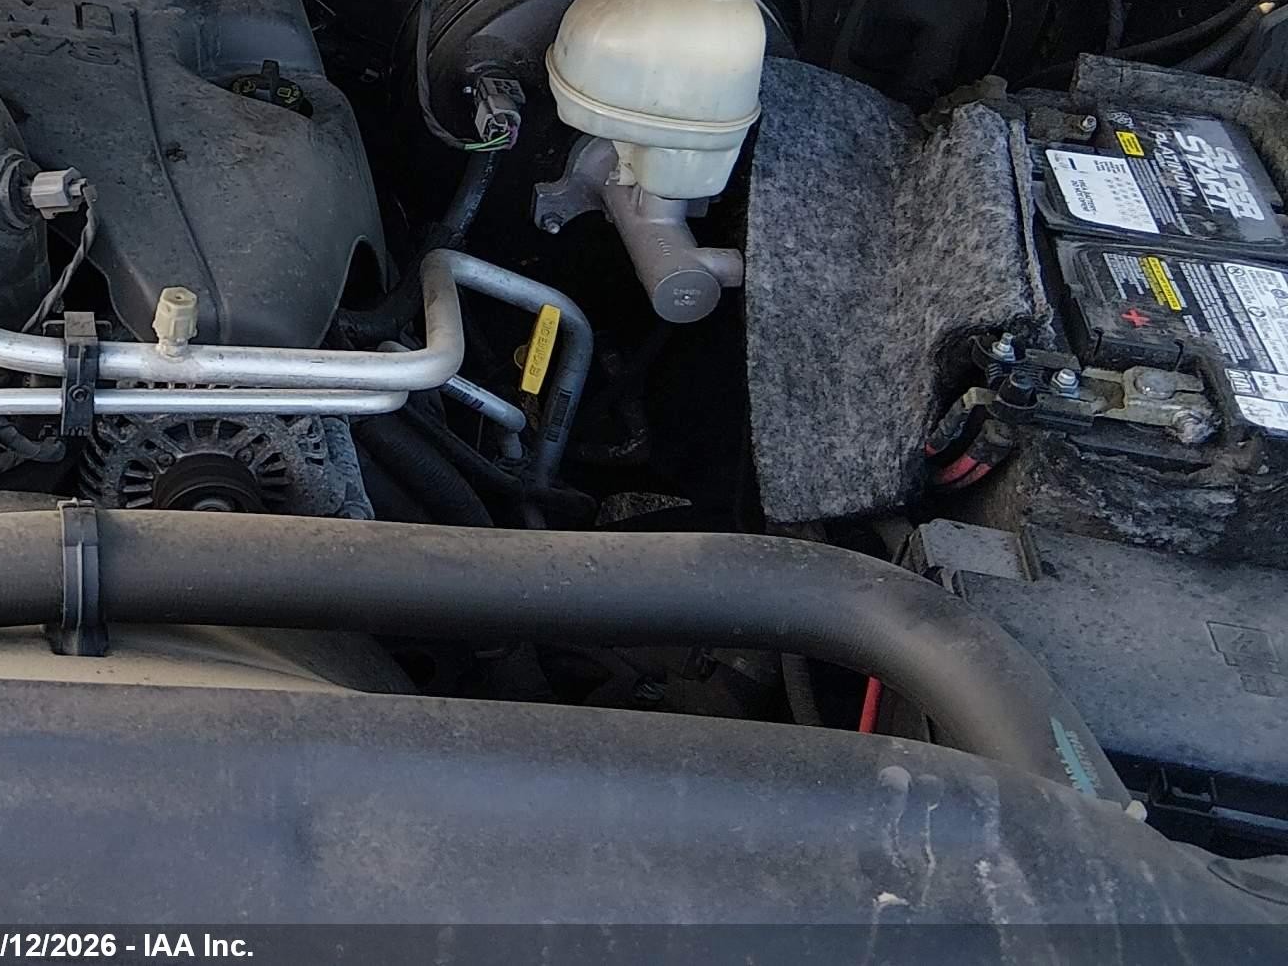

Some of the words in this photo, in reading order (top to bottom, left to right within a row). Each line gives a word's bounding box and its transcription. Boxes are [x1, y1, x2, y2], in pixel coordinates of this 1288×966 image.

[1150, 130, 1197, 197] PLATINUM
[1173, 131, 1241, 219] START
[1211, 146, 1265, 221] SUPER
